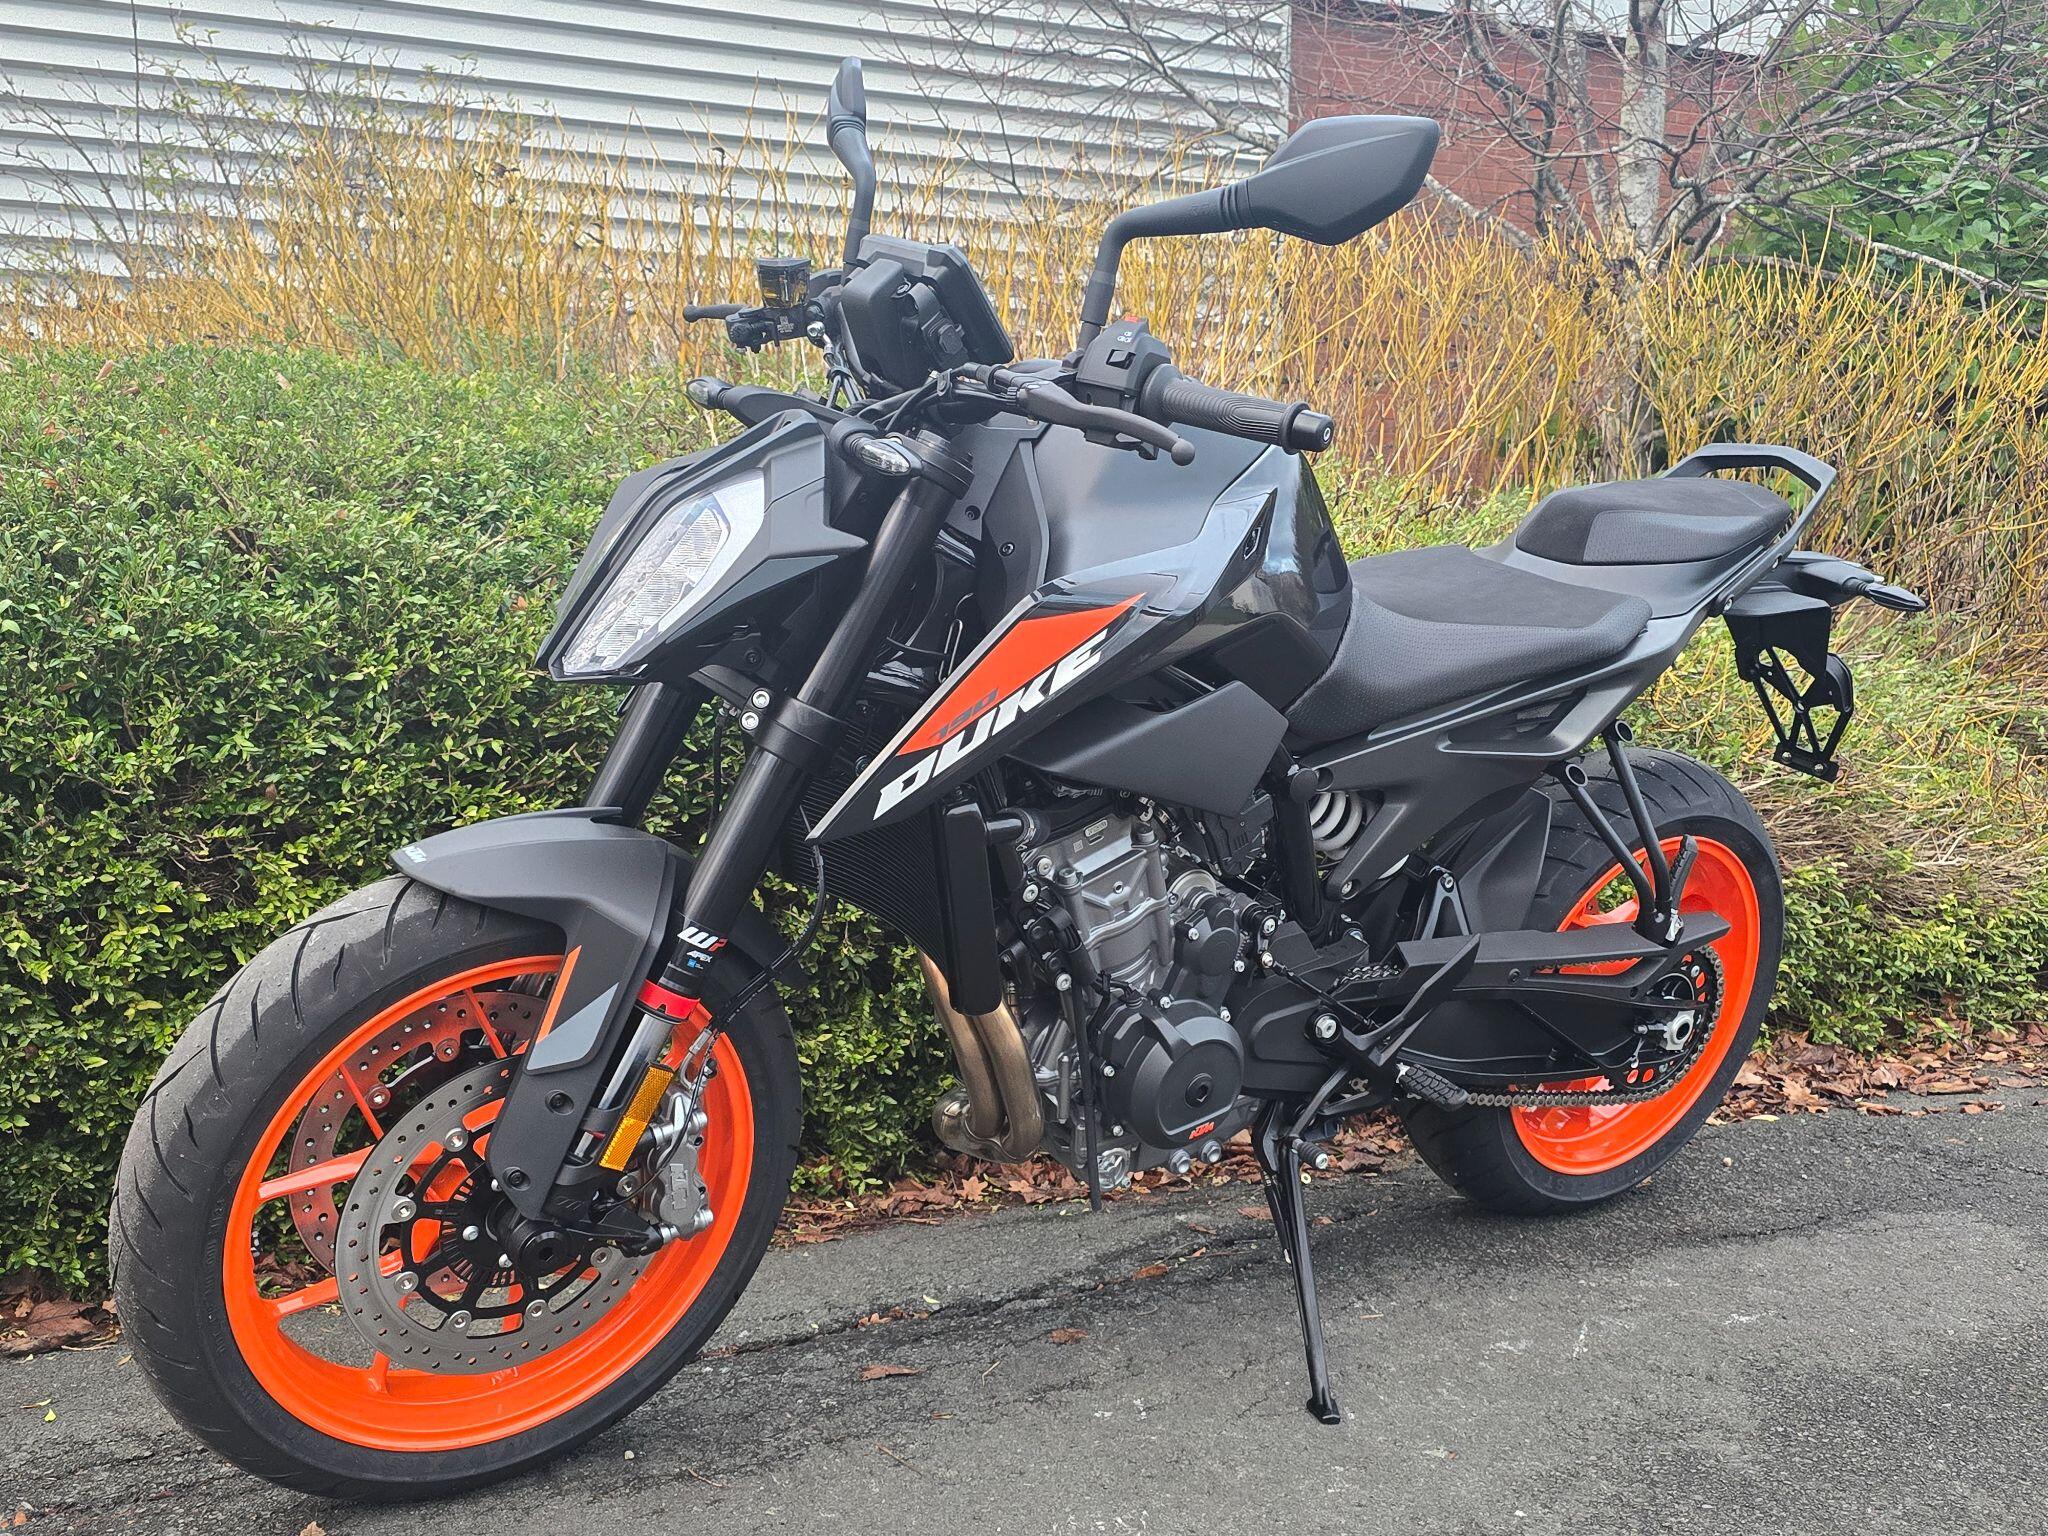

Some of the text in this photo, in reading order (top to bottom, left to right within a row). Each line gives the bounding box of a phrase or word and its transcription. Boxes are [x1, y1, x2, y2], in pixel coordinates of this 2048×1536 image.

[873, 628, 1109, 821] DUKE
[928, 687, 1000, 743] 790
[677, 926, 729, 952] WP
[686, 950, 714, 963] APEX
[1188, 1121, 1216, 1140] KTM
